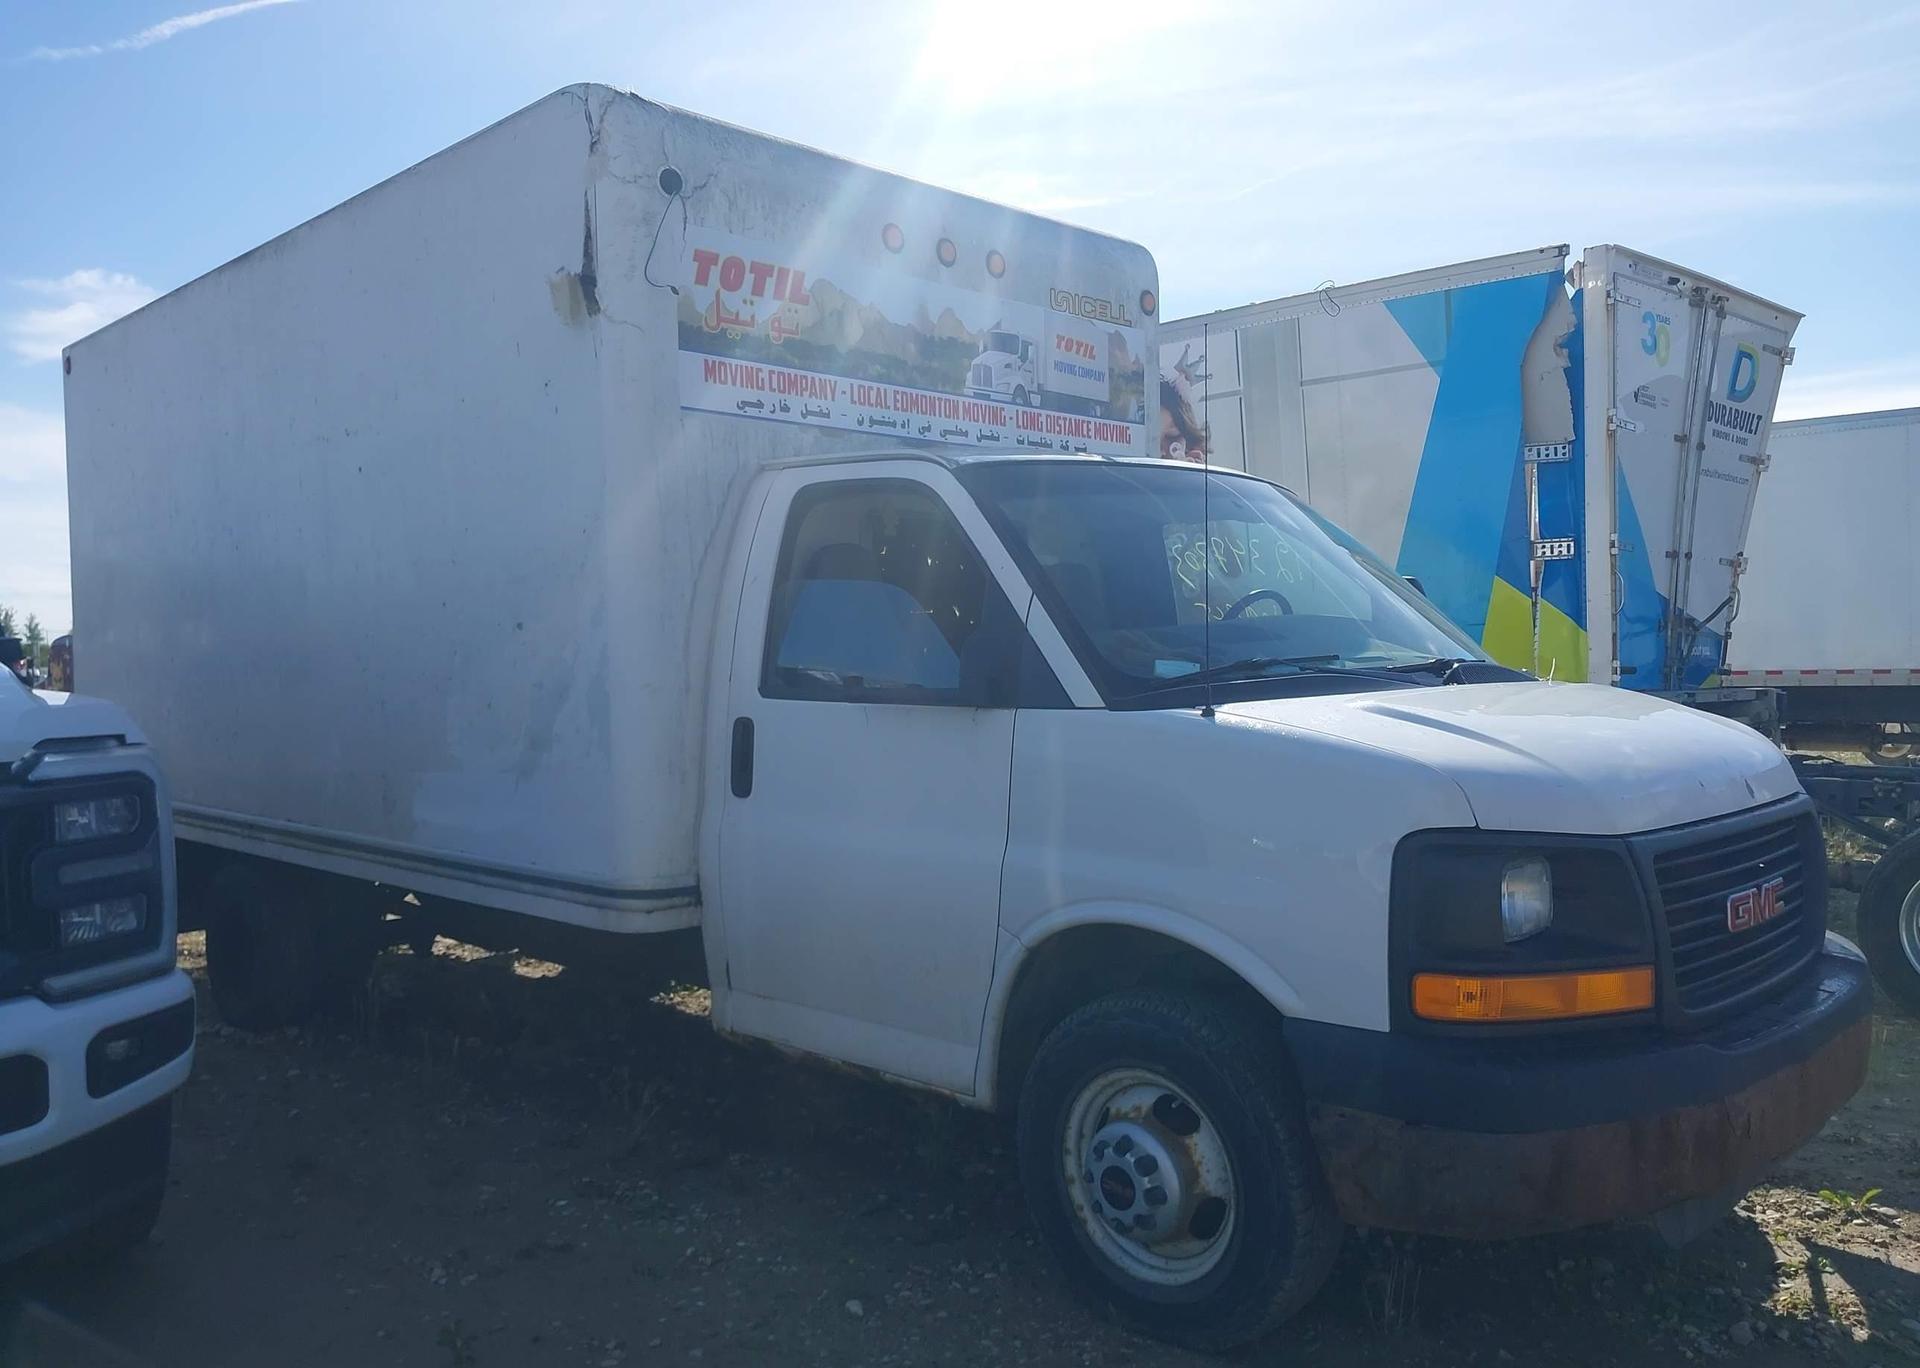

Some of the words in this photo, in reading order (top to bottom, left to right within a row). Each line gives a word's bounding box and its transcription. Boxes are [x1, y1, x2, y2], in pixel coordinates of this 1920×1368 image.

[693, 249, 810, 306] TOTIL
[1050, 288, 1132, 327] UNICELL
[1056, 334, 1096, 361] TOTIL
[1054, 360, 1077, 376] MOVING
[1078, 366, 1105, 382] COMPANY
[703, 359, 765, 391] MOVING
[768, 369, 838, 401] COMPANY
[850, 383, 890, 411] LOCAL
[893, 389, 962, 420] EDMONTON
[962, 401, 1007, 427] MOVING
[1016, 409, 1044, 432] LONG
[1045, 415, 1092, 440] DISTANCE
[1094, 423, 1131, 445] MOVING
[1707, 400, 1763, 436] DURABUILT
[1727, 876, 1786, 933] GMC
